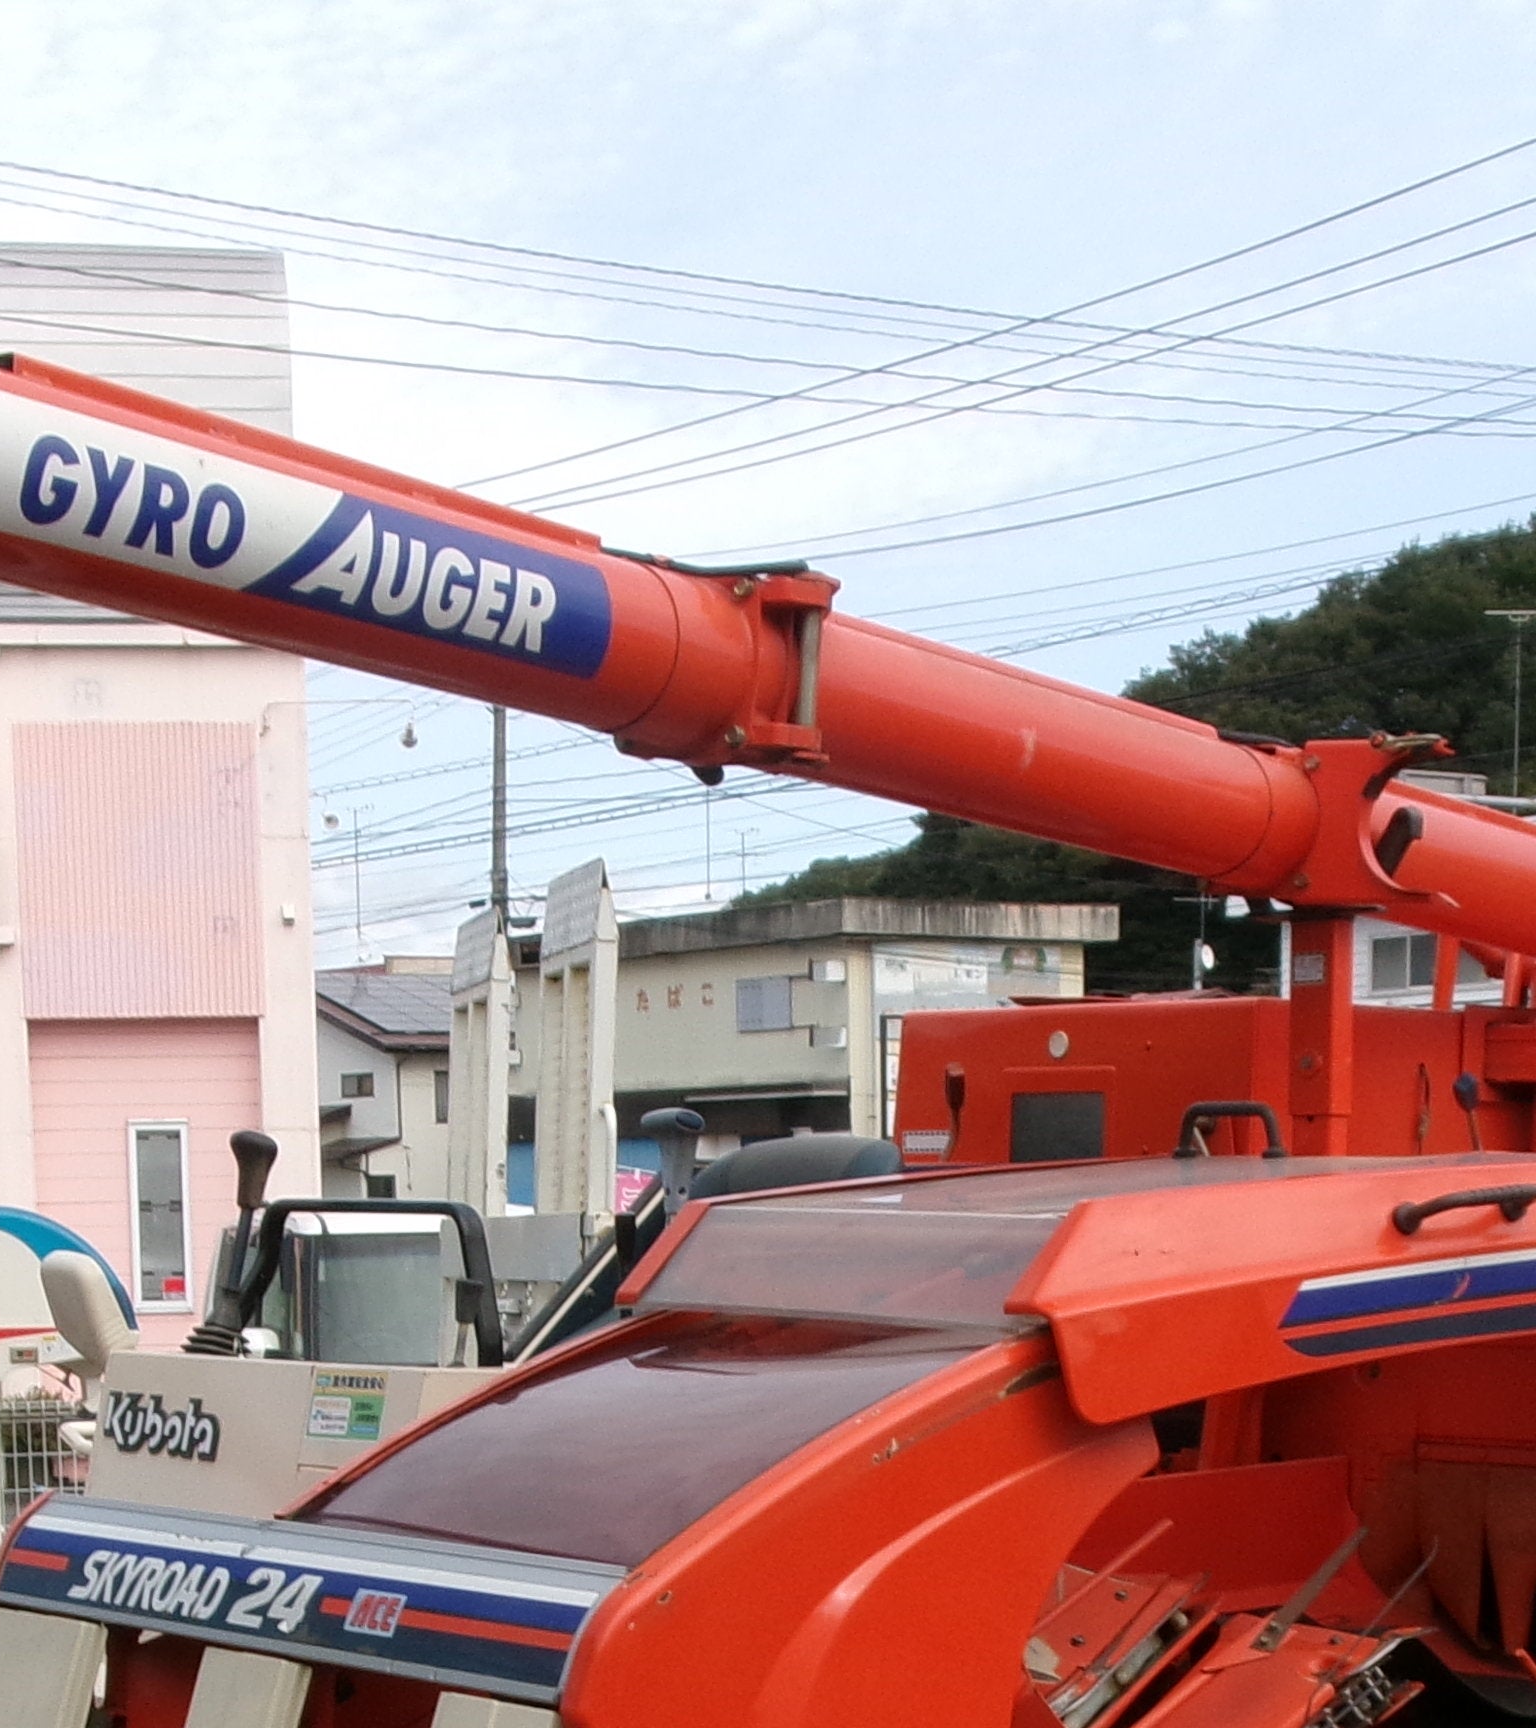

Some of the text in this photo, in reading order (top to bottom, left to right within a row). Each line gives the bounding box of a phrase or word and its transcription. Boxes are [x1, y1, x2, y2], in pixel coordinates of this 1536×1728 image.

[19, 433, 557, 655] GYRO AUGER
[103, 1390, 221, 1462] Kubota
[66, 1549, 401, 1634] SKYROAD 24 ACE
